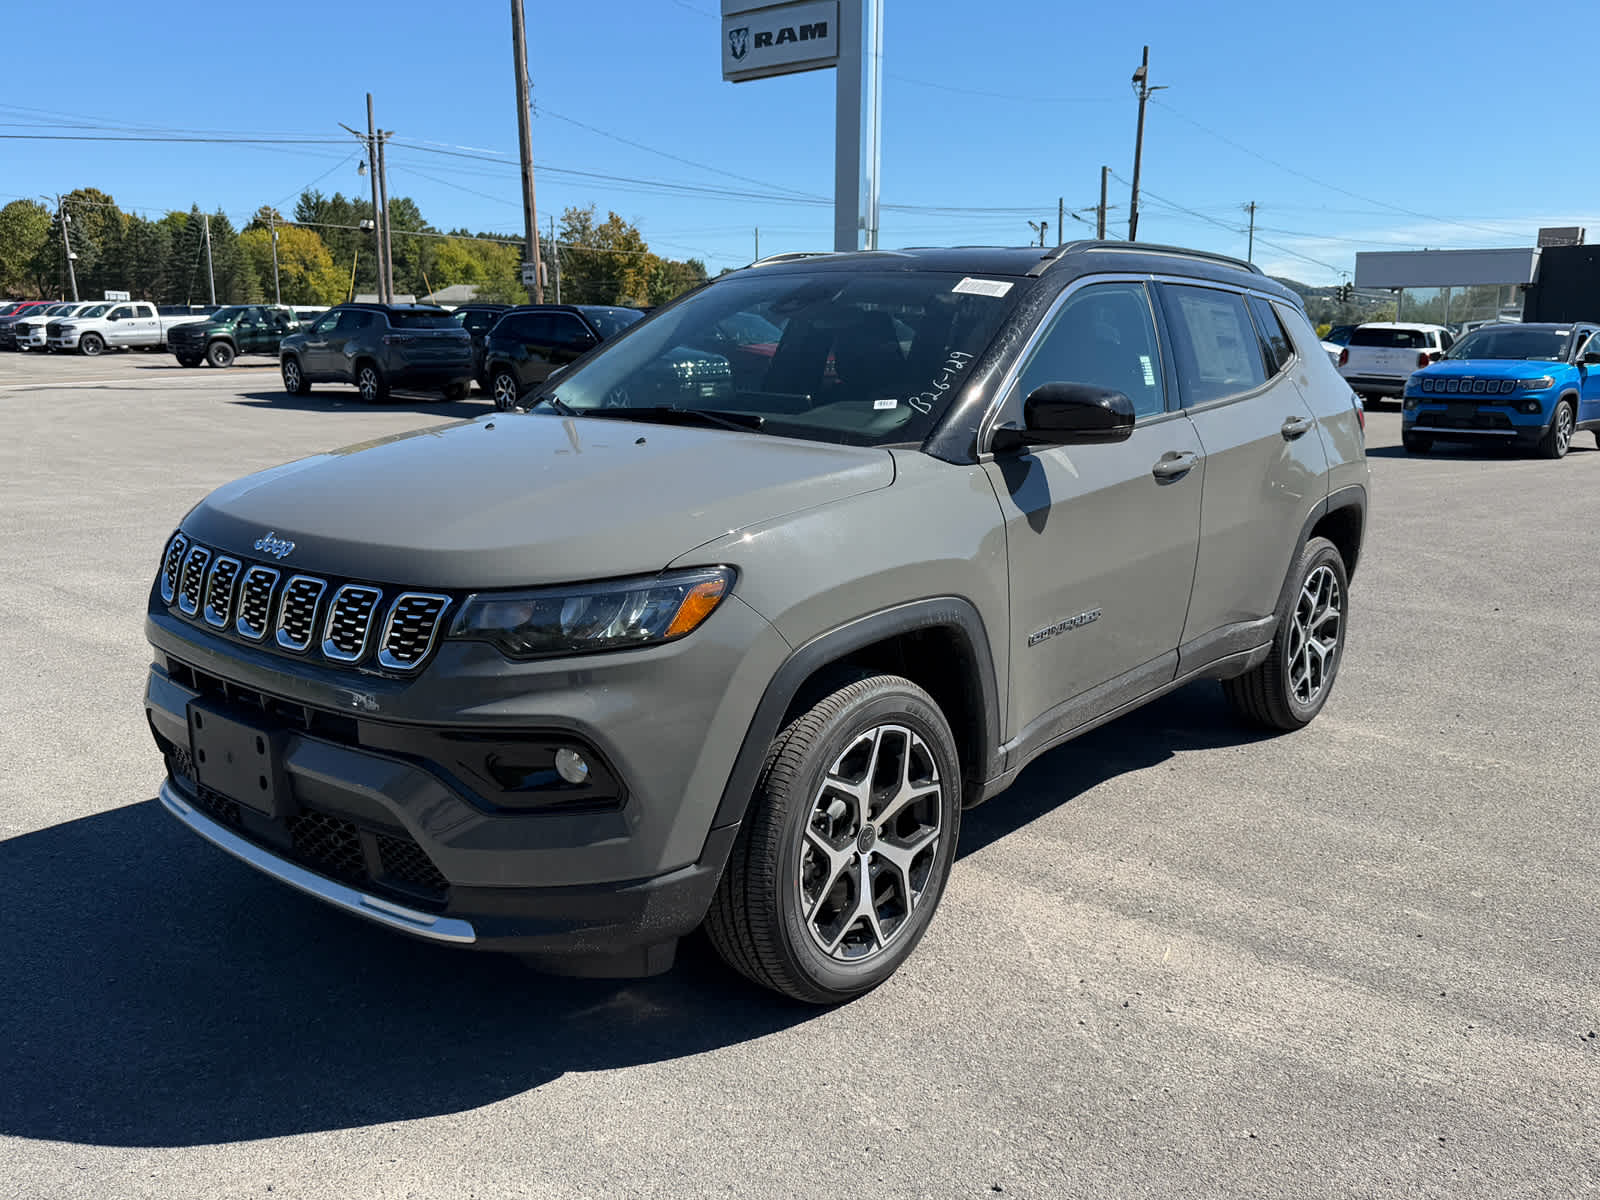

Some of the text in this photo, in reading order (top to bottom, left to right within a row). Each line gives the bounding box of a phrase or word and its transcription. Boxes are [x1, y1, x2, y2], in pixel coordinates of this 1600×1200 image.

[754, 22, 828, 48] RAM
[908, 351, 974, 414] B26-129
[254, 531, 296, 559] Jeep
